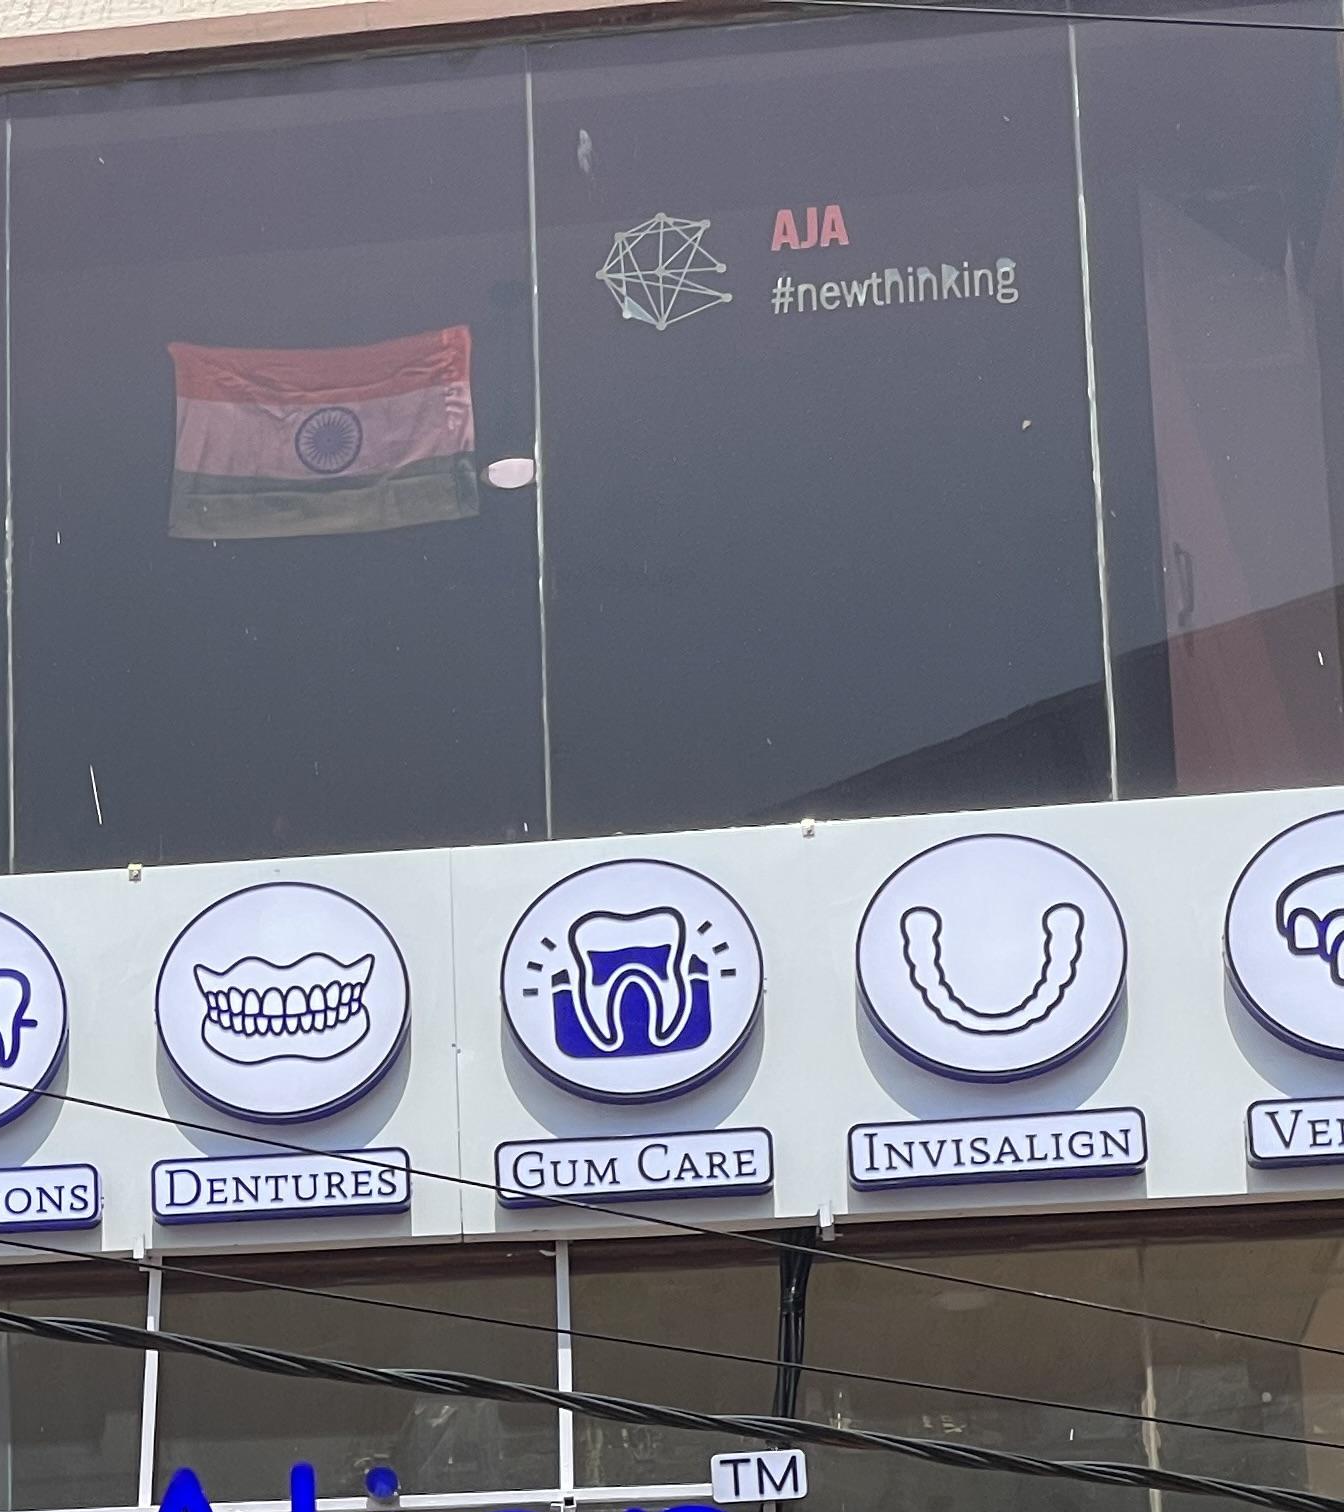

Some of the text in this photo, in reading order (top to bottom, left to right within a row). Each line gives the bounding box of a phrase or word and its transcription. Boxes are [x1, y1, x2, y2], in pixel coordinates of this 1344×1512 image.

[771, 205, 849, 251] AJA
[771, 257, 1019, 314] #newthinking
[863, 1127, 1131, 1172] INVISALIGN
[1264, 1109, 1344, 1150] VE
[166, 1167, 397, 1209] DENTURES
[512, 1144, 758, 1190] GUM CARE
[720, 1454, 800, 1497] TM
